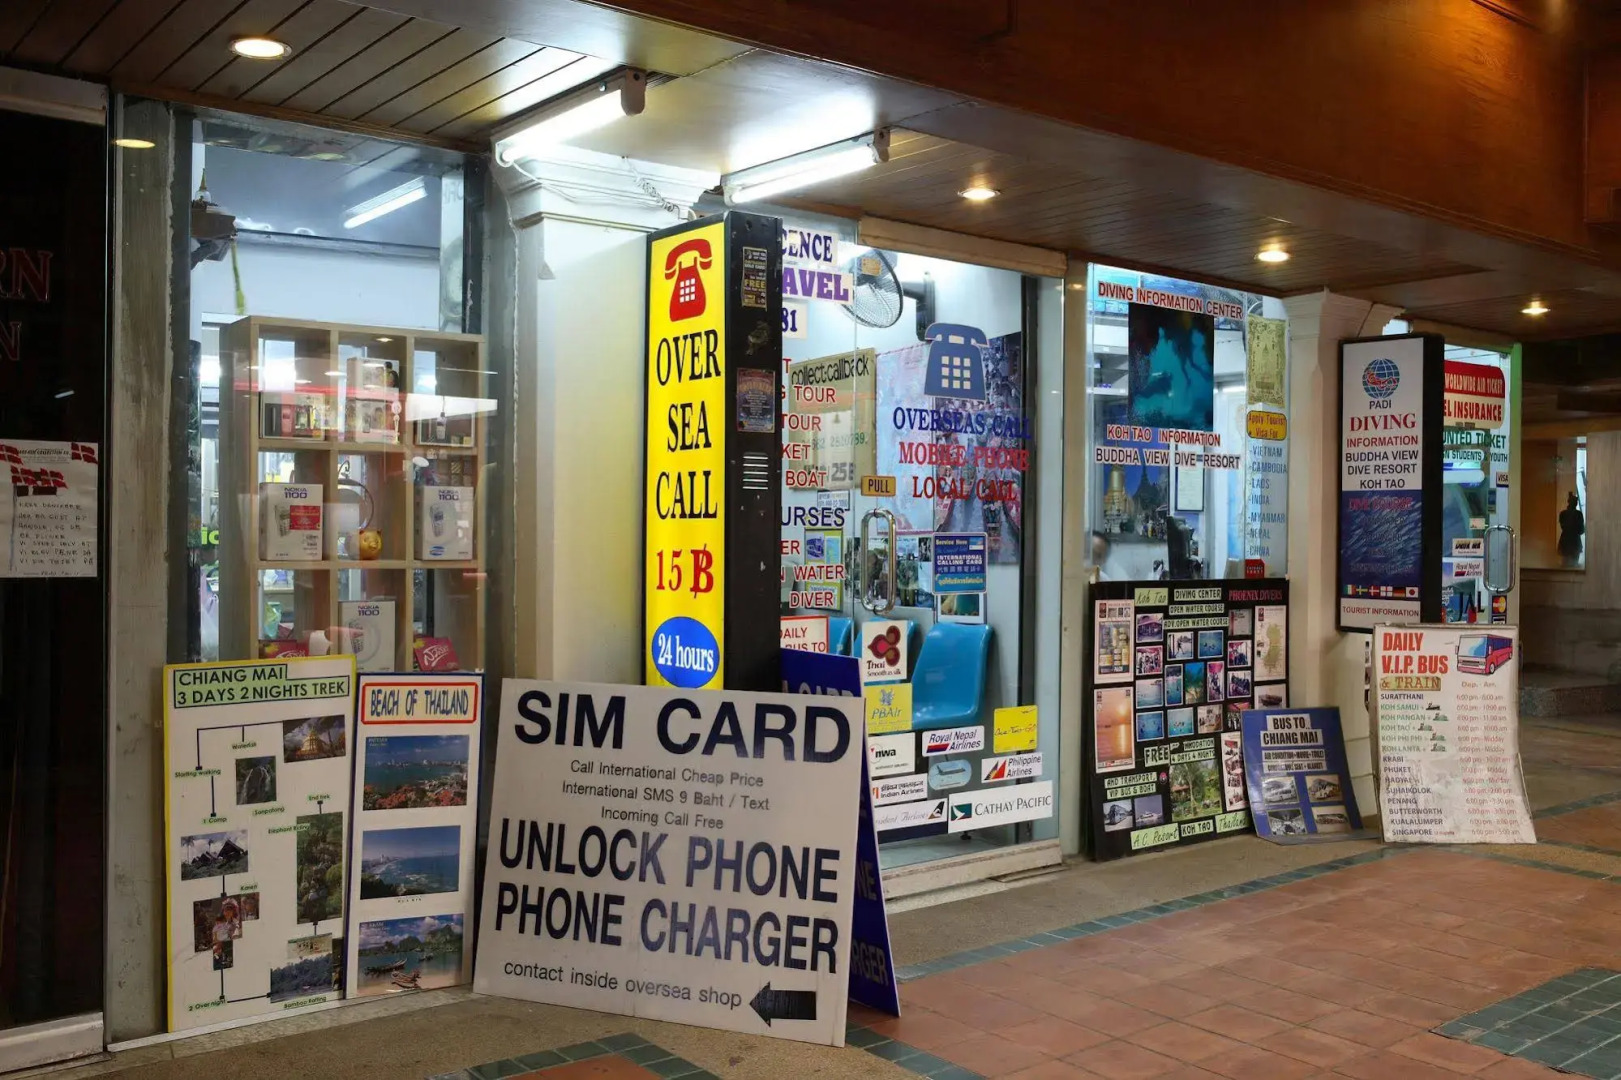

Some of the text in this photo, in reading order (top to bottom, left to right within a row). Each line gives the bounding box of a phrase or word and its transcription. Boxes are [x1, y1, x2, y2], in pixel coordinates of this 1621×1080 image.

[1098, 282, 1243, 320] DIVING INFORMATION CENTER
[656, 329, 721, 386] OVER
[794, 386, 836, 402] TOUR
[1487, 378, 1503, 394] TICKET
[1369, 400, 1391, 410] PADI
[1453, 400, 1502, 421] INSURANCE
[667, 400, 712, 452] SEA
[893, 406, 1032, 441] OVERSEAS CALL
[1350, 413, 1416, 431] DIVING
[1107, 425, 1221, 446] KOH TAO INFORMATION
[1347, 435, 1418, 448] INFORMATION
[1476, 432, 1506, 449] TICKET
[899, 441, 1030, 472] MOBILE PHONE
[1096, 448, 1240, 469] BUDDHA VIEW DIVE RESORT
[1346, 450, 1419, 462] BUDDHA VIEW
[1452, 450, 1508, 462] STUDENTS YOUTH
[1347, 463, 1417, 475] DIVE RESORT
[785, 470, 827, 487] BOAT
[868, 479, 890, 493] PULL
[1360, 479, 1405, 489] KOH TAO
[1498, 474, 1509, 482] VISA
[656, 470, 718, 520] CALL
[912, 476, 1018, 501] LOCAL CALL
[656, 549, 683, 591] 15
[794, 565, 844, 581] WATER
[791, 592, 833, 607] DIVER
[1137, 590, 1167, 604] Koh Tao
[1175, 589, 1221, 599] DIVING CENTER
[1170, 604, 1223, 614] OPEN WATER COURSE
[1342, 606, 1419, 617] TOURIST INFORMATION
[1191, 617, 1228, 627] WATER COURSE
[1383, 632, 1424, 651] DAILY
[658, 633, 714, 672] 24 hours
[867, 660, 885, 670] Thai
[1382, 655, 1448, 674] V.I.P. BUS
[179, 666, 283, 686] CHIANG MAI
[867, 670, 886, 678] Smooth
[1381, 677, 1441, 689] & TRAIN
[178, 681, 345, 705] 3 DAYS 2 NIGHTS TREK
[371, 688, 469, 717] BEACH OF THAILAND
[872, 707, 902, 719] PBAir
[514, 690, 851, 764] SIM CARD
[1273, 717, 1292, 730] BUS
[929, 729, 977, 744] Royal Nepal
[1263, 731, 1319, 745] CHIANG MAI
[875, 749, 896, 758] nwa
[950, 740, 981, 751] Airlines
[1008, 755, 1041, 767] Philippine
[1145, 746, 1169, 765] FREE
[1179, 753, 1191, 762] DAYS
[571, 759, 763, 787] Call International Cheap Price
[1007, 768, 1032, 777] Airlines
[1106, 777, 1119, 786] AND
[562, 780, 770, 811] International SMS 9 Baht / Text
[901, 788, 924, 796] Airlines
[1109, 784, 1154, 798] VIP BUS BOAT
[975, 795, 1052, 816] CATHAY PACIFIC
[601, 806, 724, 829] Incoming Call Free
[1153, 827, 1178, 844] Resort
[1182, 821, 1211, 834] KOH TAO
[500, 817, 840, 903] UNLOCK PHONE
[494, 881, 839, 974] PHONE CHARGER
[504, 961, 742, 1011] contact inside oversea shop
